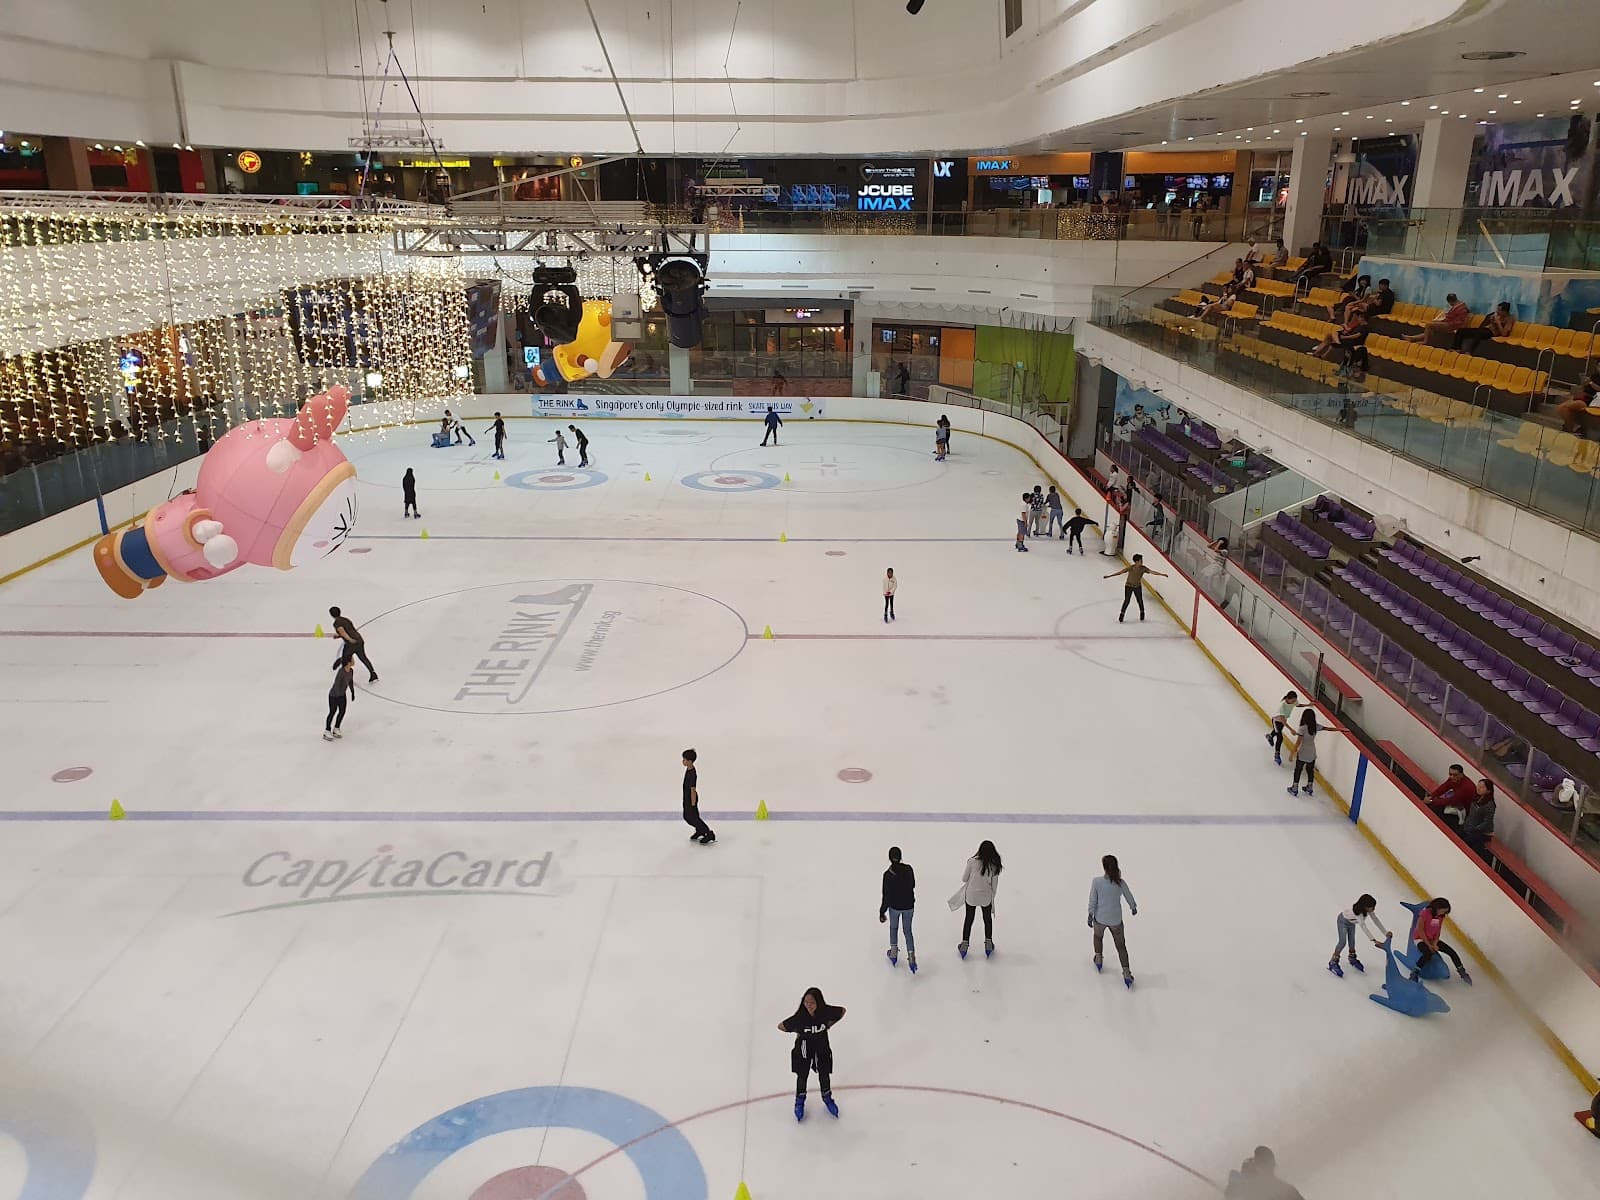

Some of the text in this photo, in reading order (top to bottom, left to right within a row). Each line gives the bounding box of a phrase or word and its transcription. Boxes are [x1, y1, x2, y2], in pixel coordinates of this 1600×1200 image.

[976, 160, 1010, 170] IMAX
[858, 185, 914, 196] JCUBE
[1348, 175, 1409, 206] IMAX
[1478, 167, 1580, 207] IMAX
[857, 197, 913, 210] IMAX
[539, 399, 575, 408] THE RINK
[595, 399, 644, 411] Singapore's
[646, 400, 664, 411] only
[726, 401, 743, 411] rink
[453, 611, 561, 701] THE RINK
[242, 844, 553, 898] CapitaCard
